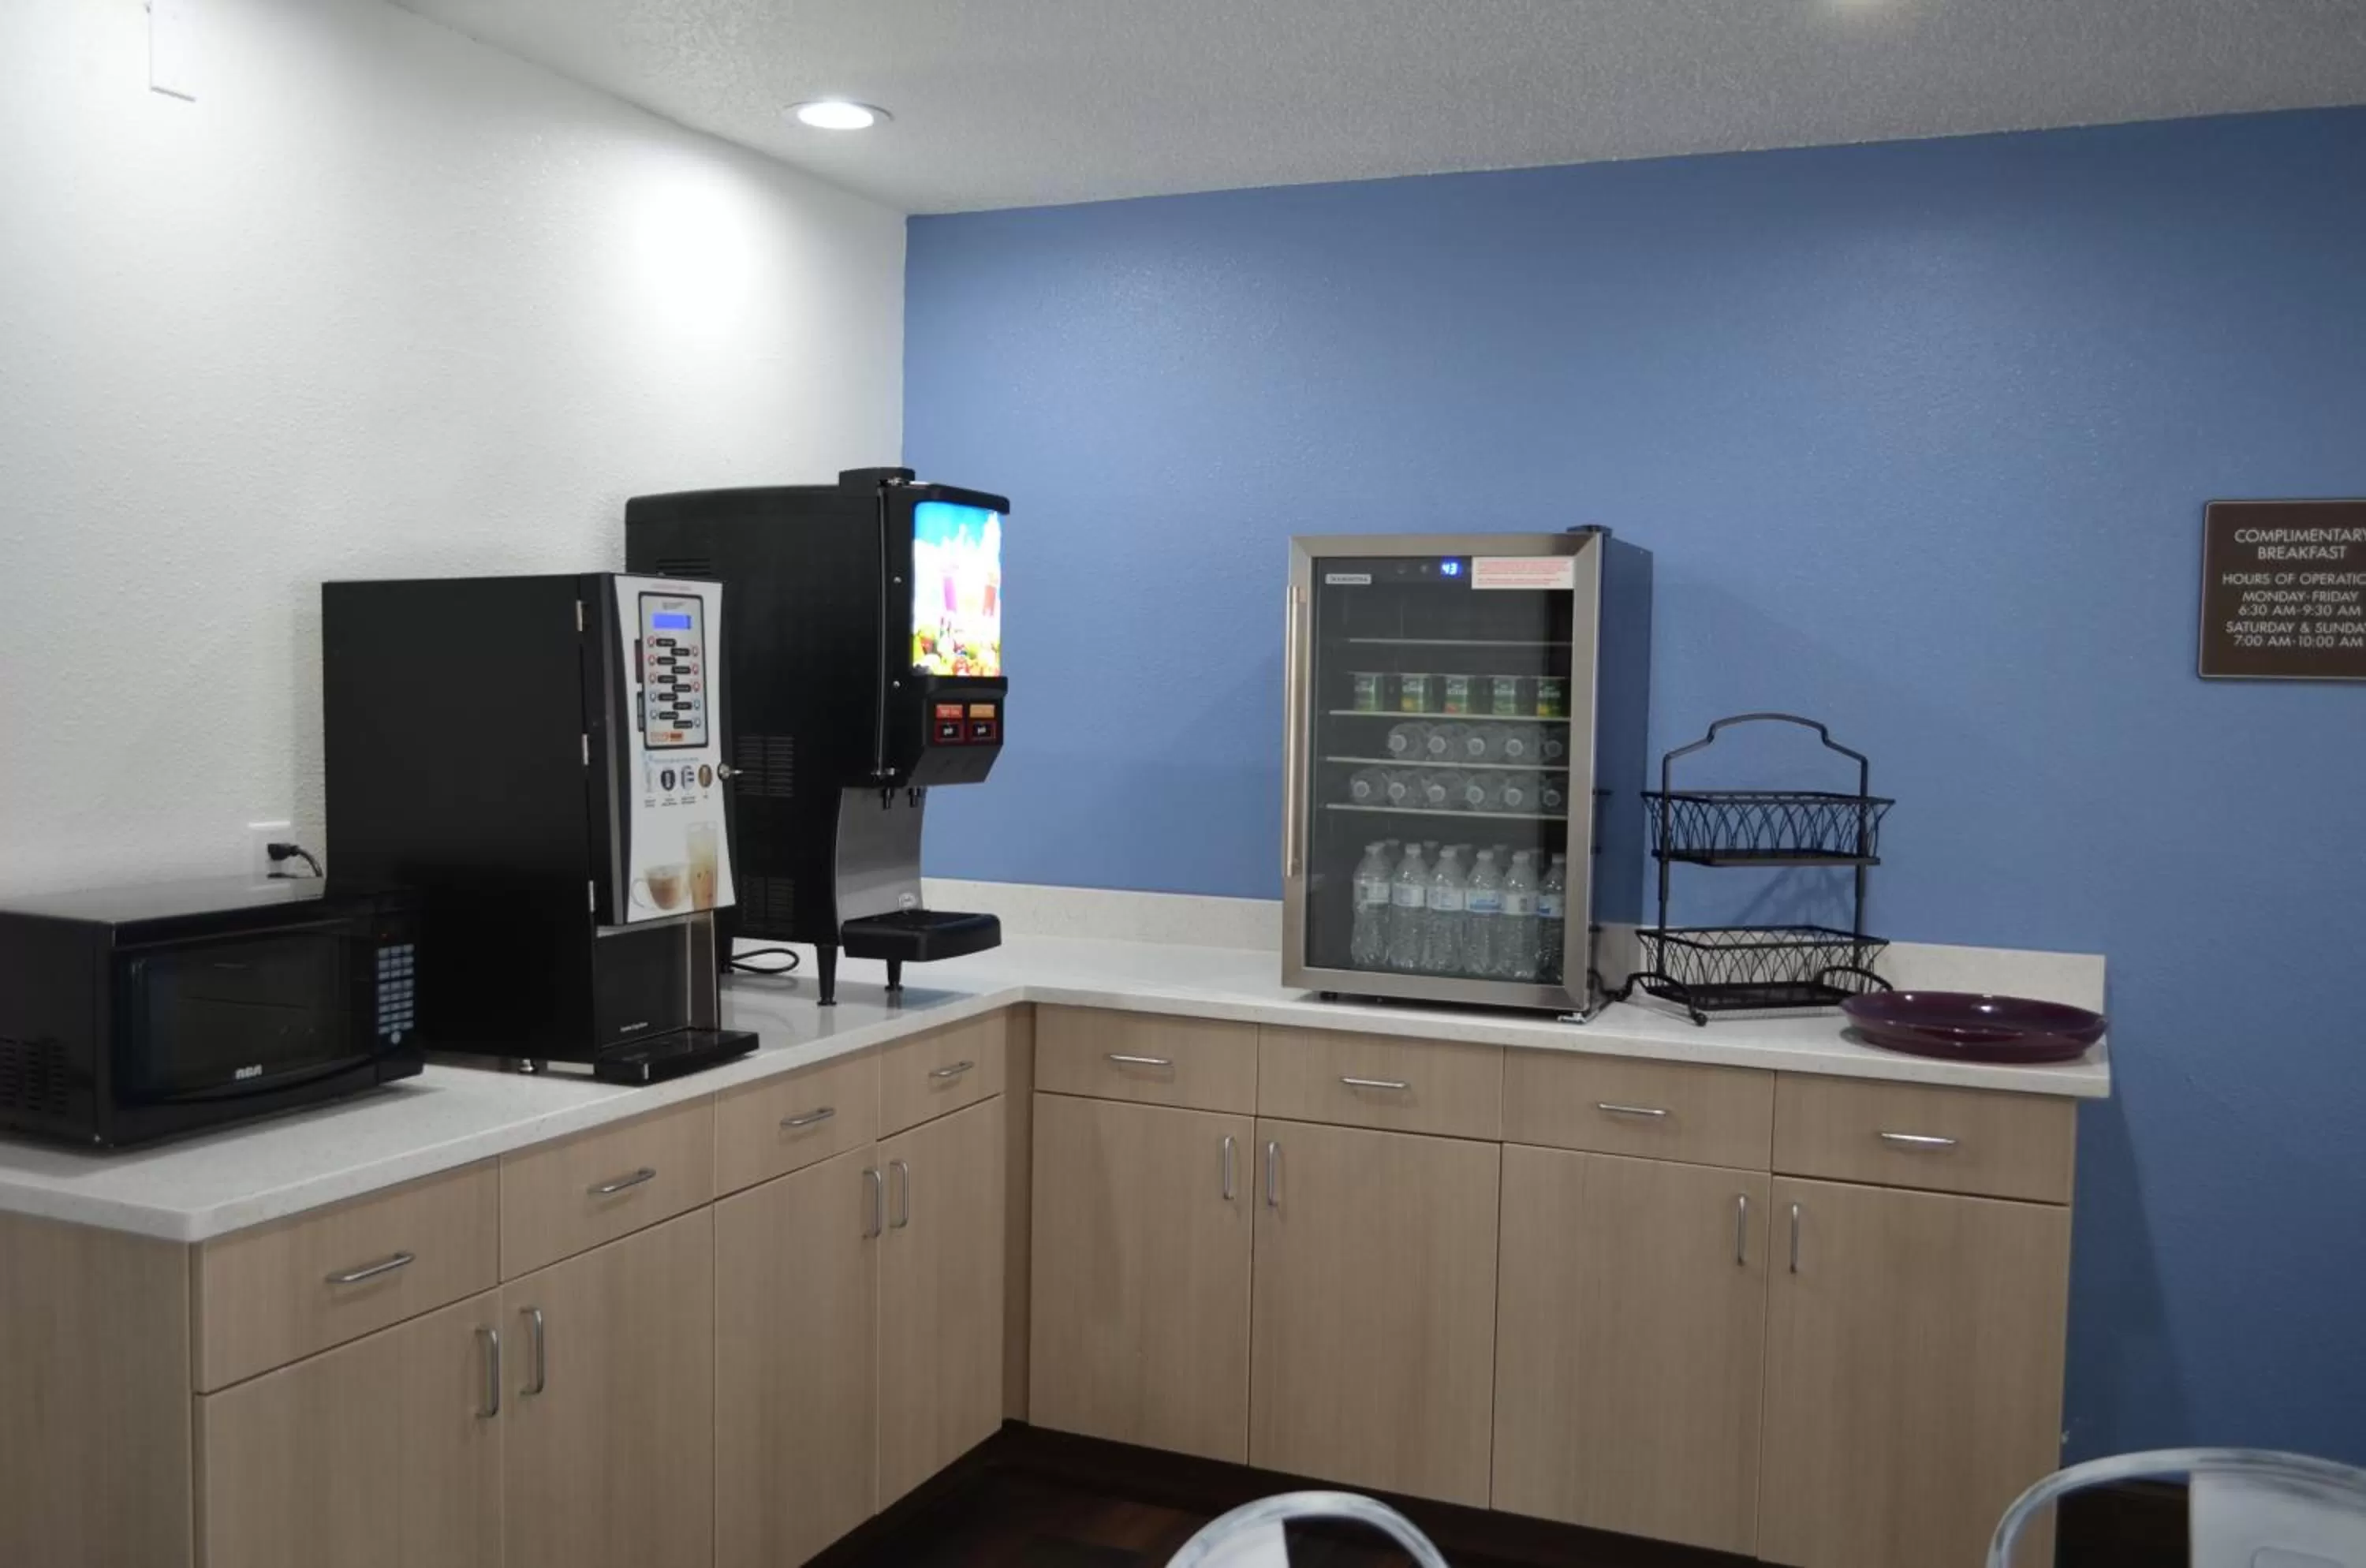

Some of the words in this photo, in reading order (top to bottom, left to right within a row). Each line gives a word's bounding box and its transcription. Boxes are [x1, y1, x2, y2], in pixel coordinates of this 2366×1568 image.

[2258, 545, 2347, 559] BREAKFAST
[2222, 573, 2270, 584] HOURS
[2275, 573, 2296, 584] OF
[2238, 604, 2267, 616] 6:30
[2338, 604, 2360, 616] AM
[2226, 621, 2294, 633] SATURDAY
[2299, 622, 2310, 633] &
[2314, 622, 2366, 633] SUNDA
[2234, 634, 2263, 647] 7:00
[2338, 636, 2363, 647] AM
[235, 1064, 263, 1080] RCA
